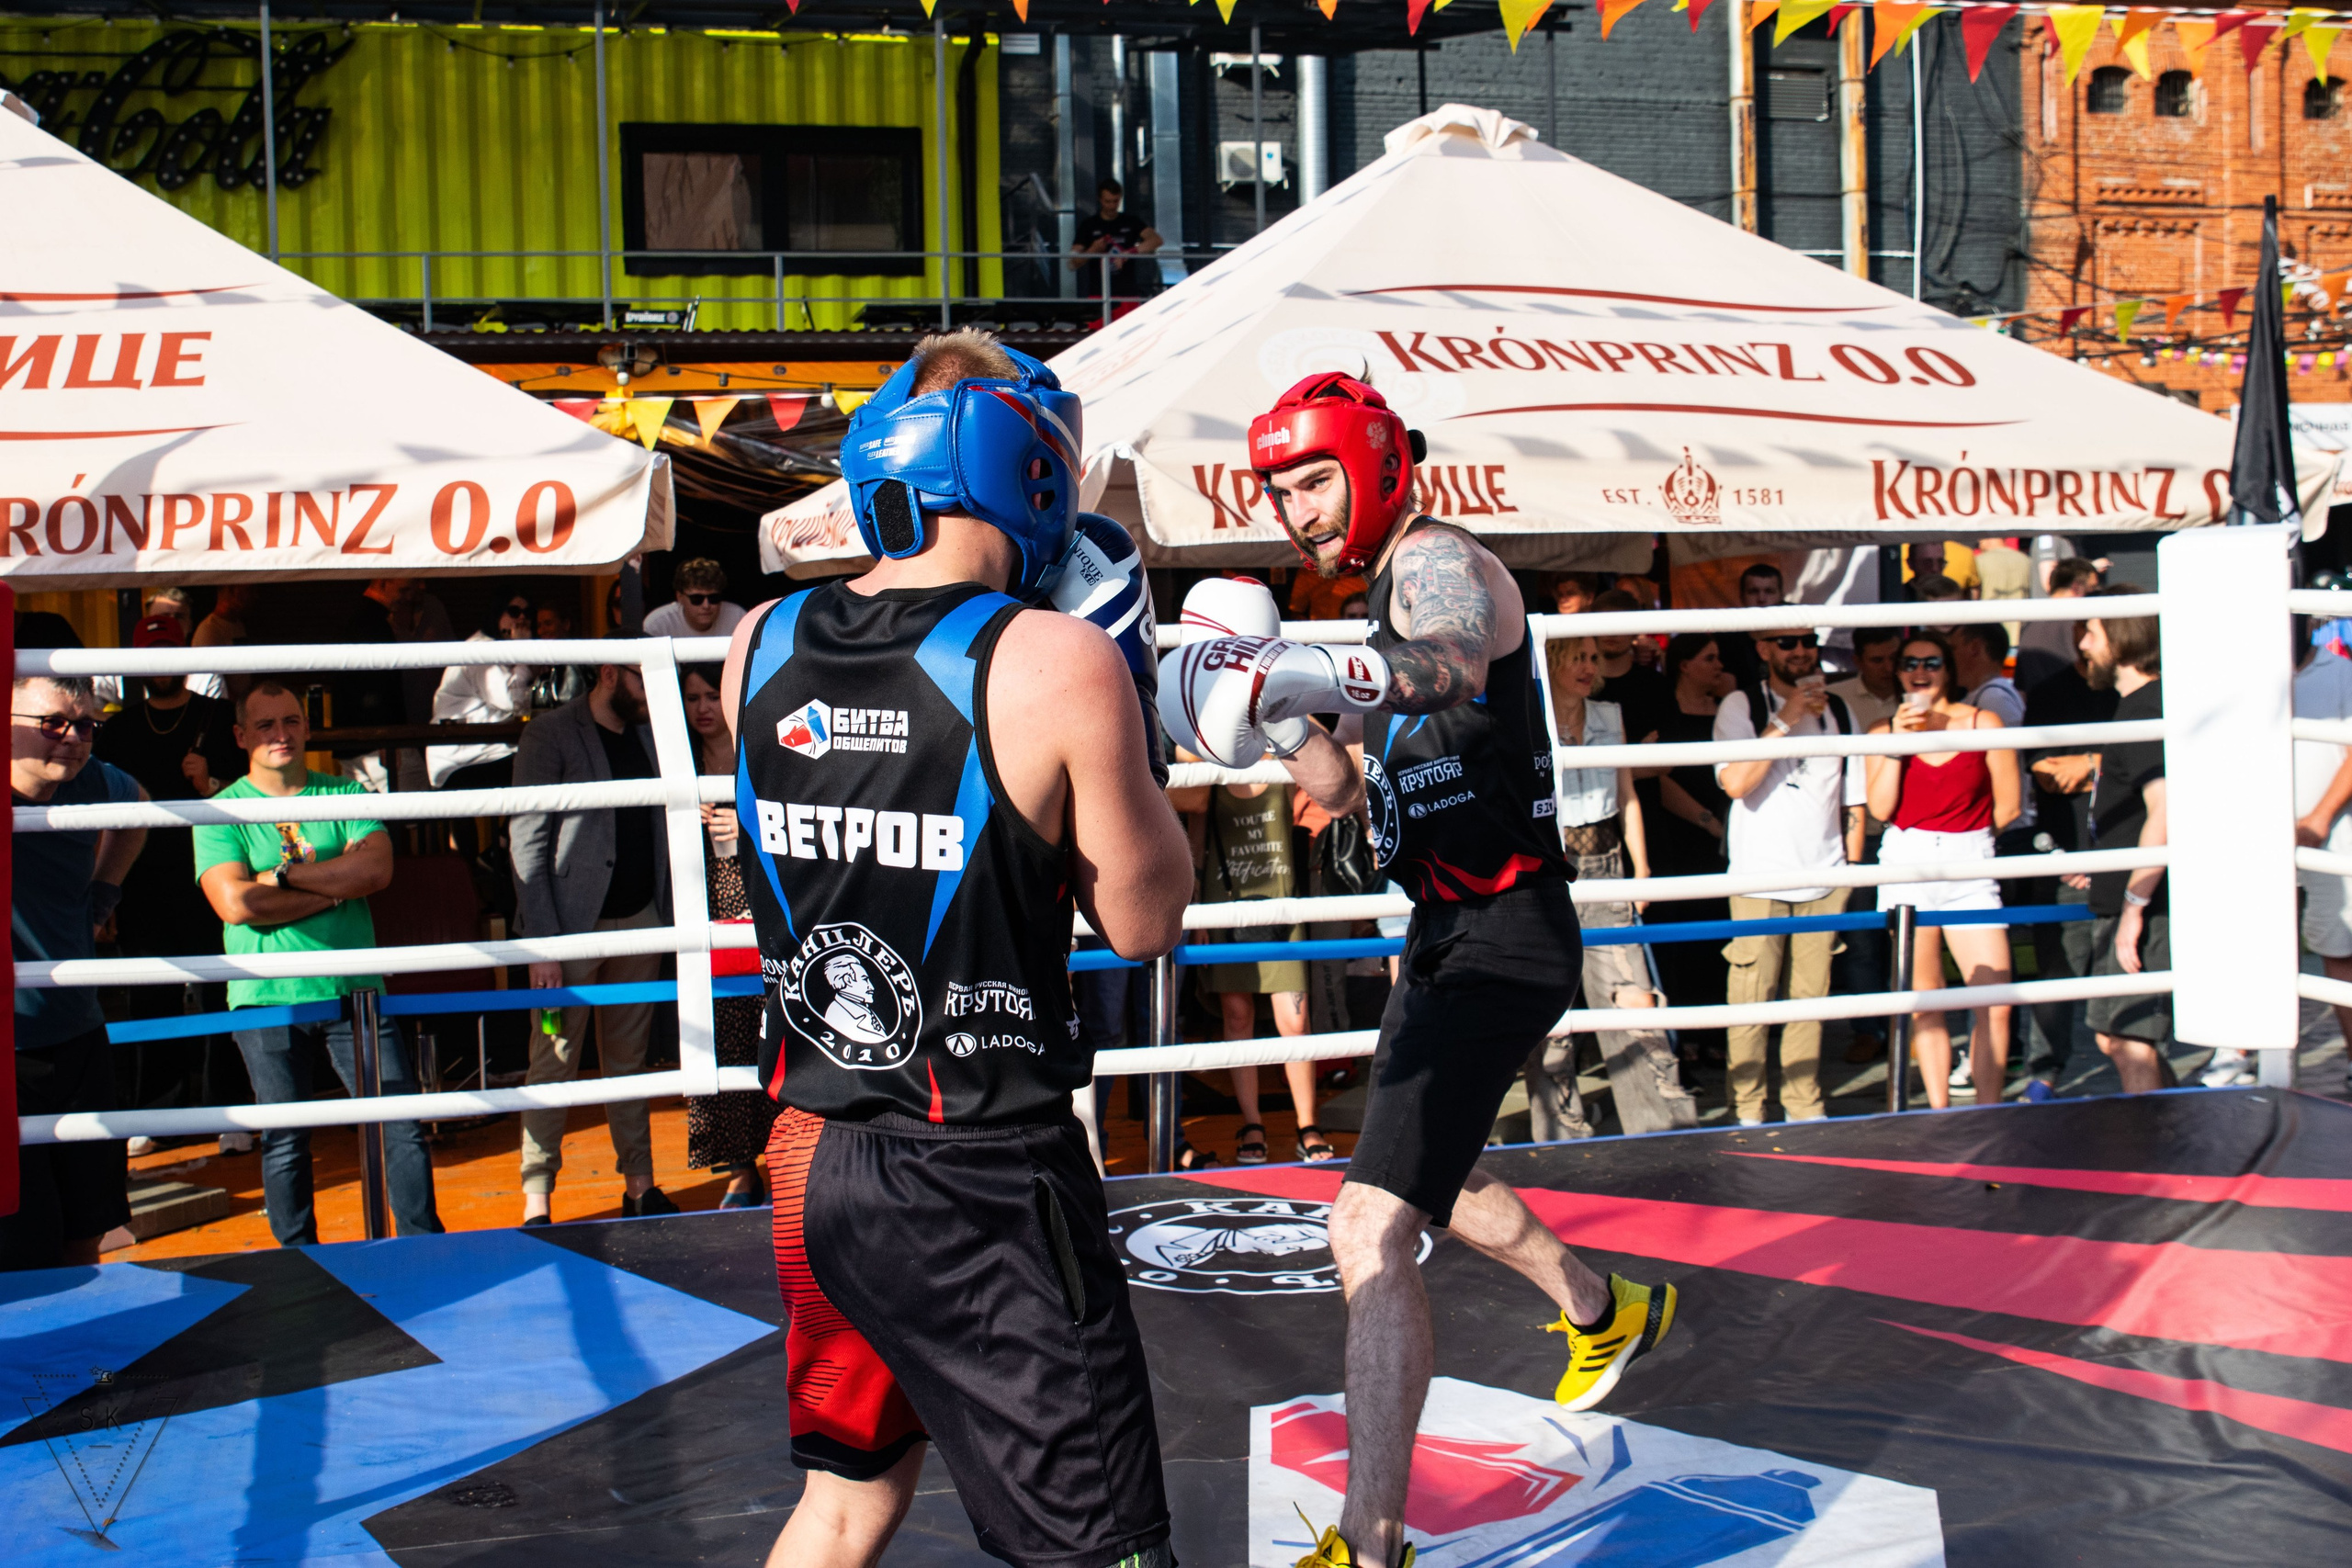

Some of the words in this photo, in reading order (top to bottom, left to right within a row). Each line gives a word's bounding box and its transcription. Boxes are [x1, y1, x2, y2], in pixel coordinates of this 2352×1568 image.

[1373, 326, 1826, 381] KRÓNPRINZ
[1829, 344, 1977, 388] 0.0
[1602, 489, 1652, 506] EST.
[1733, 488, 1784, 506] 1581
[1871, 451, 2188, 521] KRÓNPRINZ
[430, 479, 577, 556] 0.0
[832, 707, 909, 737] БИТВА
[832, 736, 908, 753] ОБЩЕПИТОВ
[1398, 761, 1463, 795] КРУТОЯР
[1427, 790, 1476, 812] LADOGA
[1233, 810, 1275, 827] YOU'RE
[755, 798, 964, 871] ВЕТРОВ
[1231, 840, 1283, 856] FAVORITE
[1247, 829, 1263, 840] MY
[784, 928, 916, 1018] КАНЦЛЕРЪ
[975, 980, 1007, 990] РУССКАЯ
[944, 989, 1036, 1021] КРУТОЯ
[820, 1031, 900, 1062] 2010
[981, 1034, 1046, 1056] LADOGA
